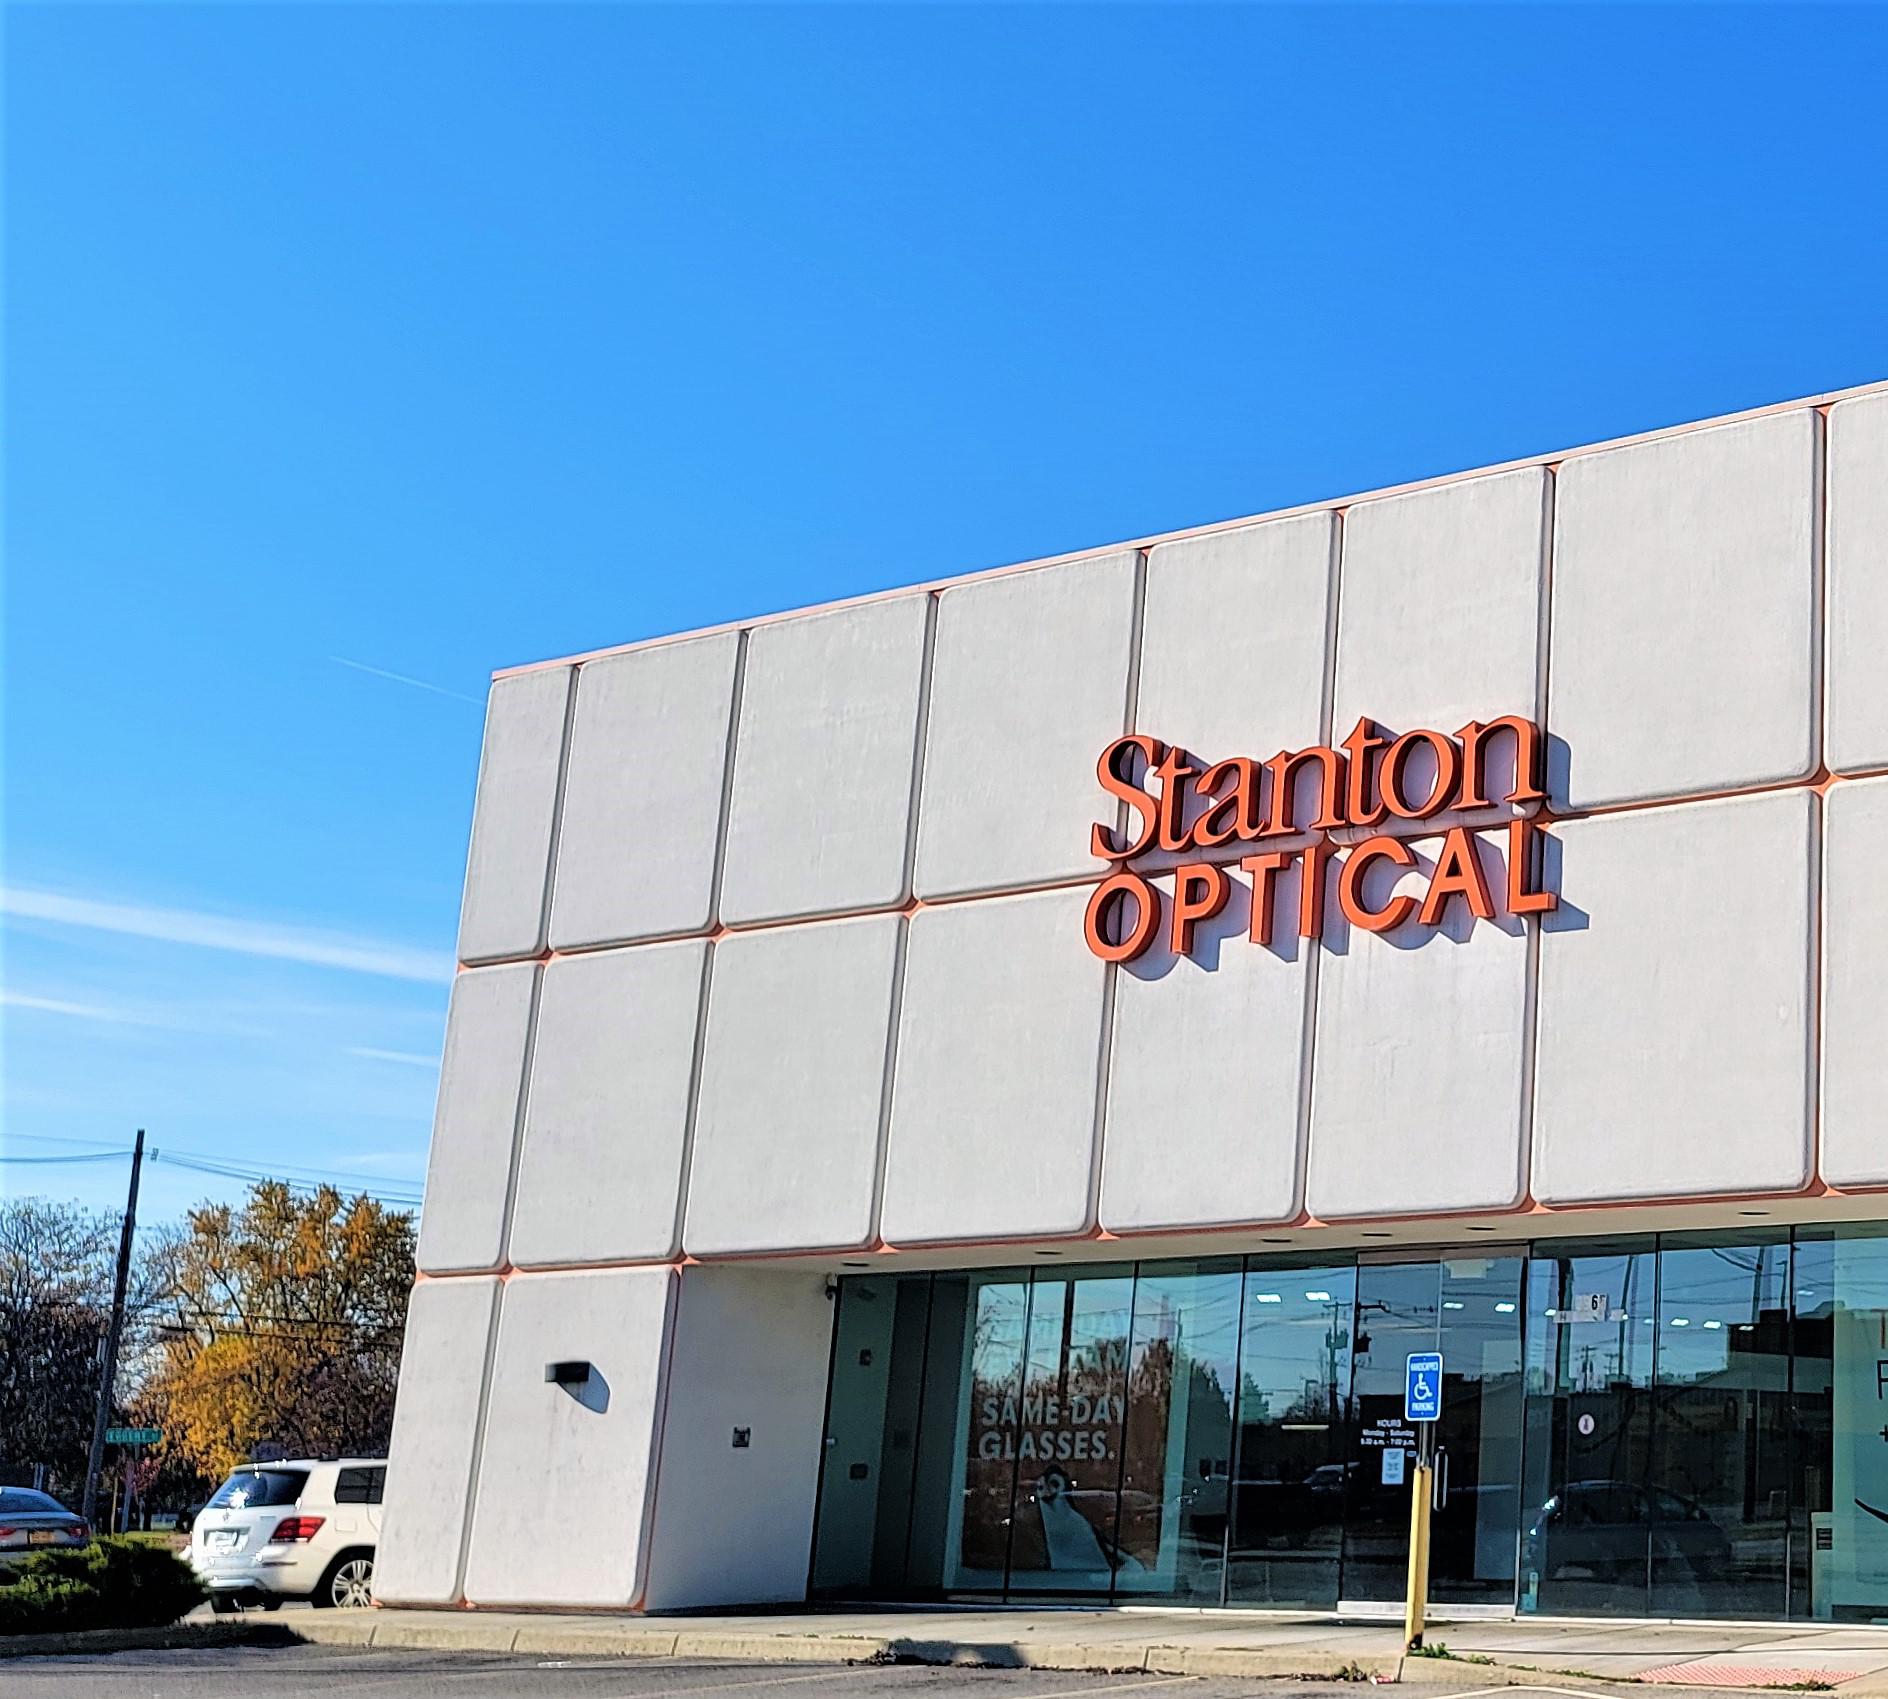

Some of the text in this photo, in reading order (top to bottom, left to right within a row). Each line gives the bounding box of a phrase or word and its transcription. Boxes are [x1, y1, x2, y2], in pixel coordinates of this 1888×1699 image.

[1091, 715, 1549, 861] Stanton
[1084, 820, 1558, 962] OPTICAL
[979, 1431, 1115, 1460] GLASSES.
[982, 1396, 1127, 1426] SAME-DAY
